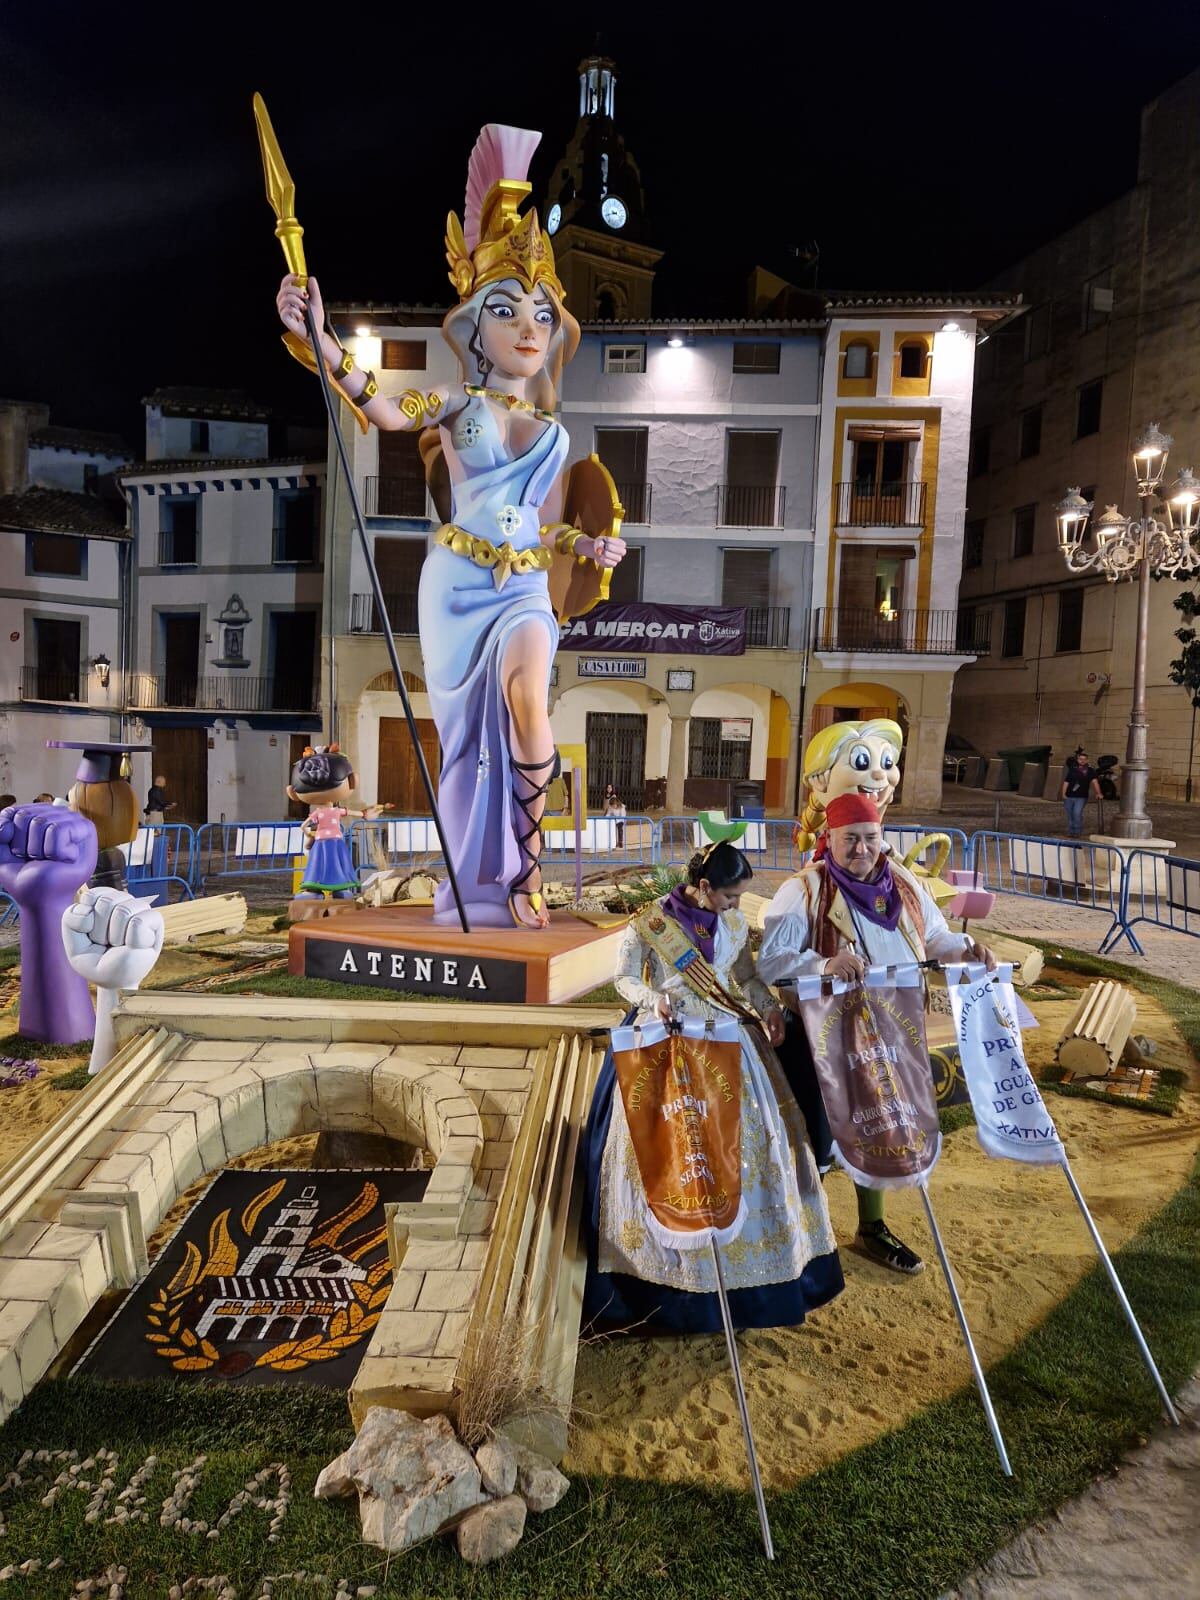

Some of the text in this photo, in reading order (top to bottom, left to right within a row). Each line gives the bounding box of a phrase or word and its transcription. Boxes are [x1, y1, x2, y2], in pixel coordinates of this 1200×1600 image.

[593, 620, 695, 639] MERCAT
[584, 661, 609, 673] CASA
[339, 948, 488, 990] ATENEA
[817, 1015, 837, 1057] JUNTA
[876, 996, 922, 1047] FALLERA
[960, 1001, 972, 1042] JUNTA
[631, 1039, 735, 1112] JUNTA LOCAL FALLERA
[1010, 1057, 1022, 1071] A
[992, 1096, 1018, 1114] DE
